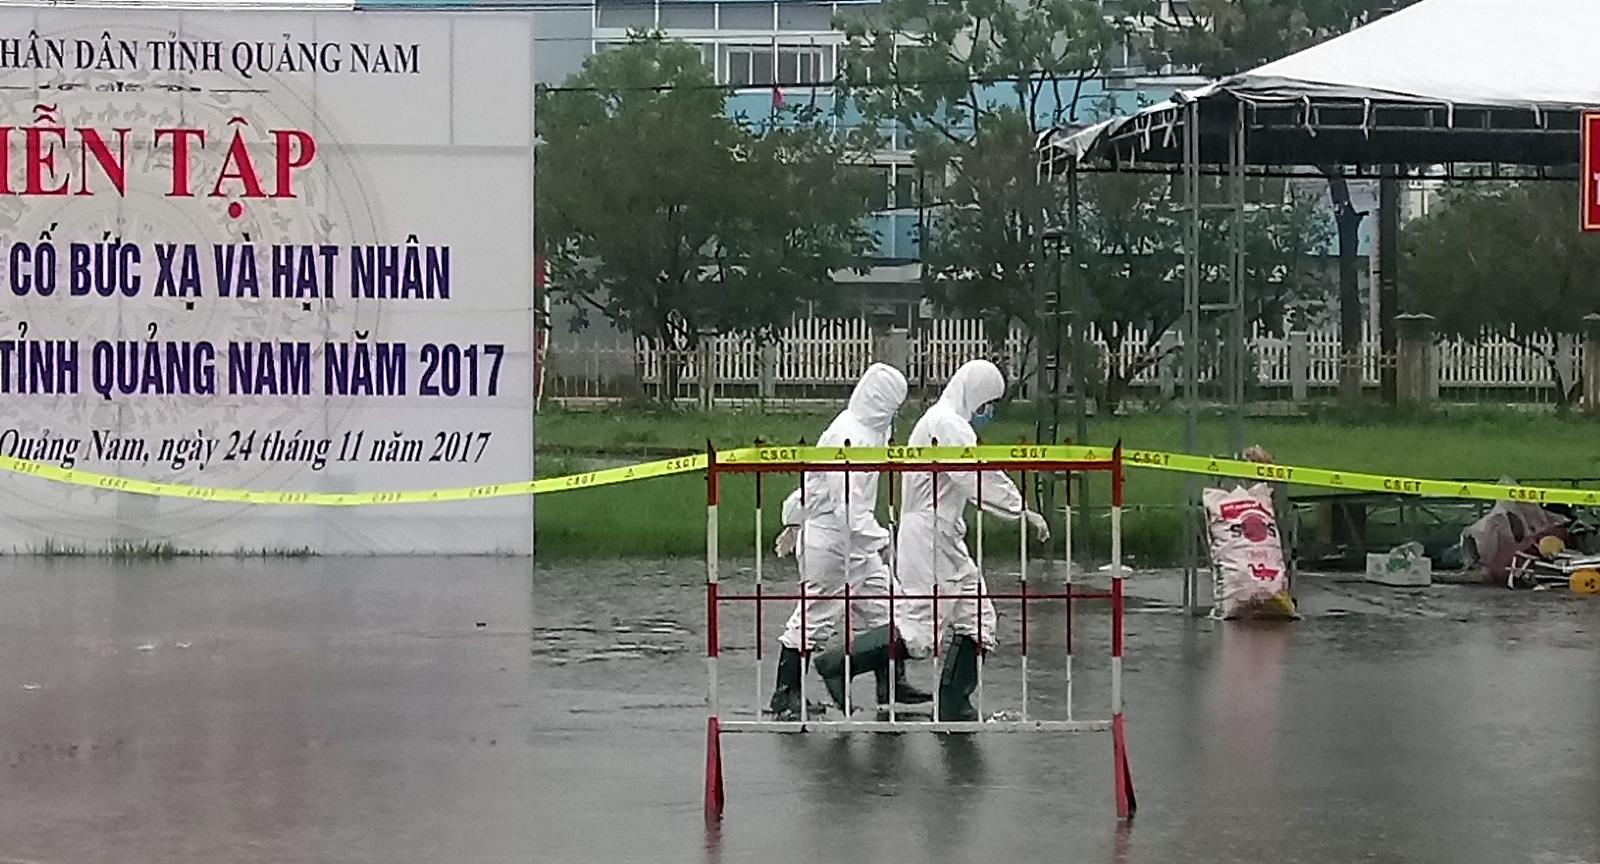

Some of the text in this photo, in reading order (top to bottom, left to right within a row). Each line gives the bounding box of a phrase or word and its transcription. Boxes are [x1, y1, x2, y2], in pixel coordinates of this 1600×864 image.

[74, 31, 138, 70] DÂN
[147, 30, 222, 72] TỈNH
[231, 33, 342, 78] QUẢNG
[350, 43, 420, 73] NAM
[153, 117, 316, 218] TẬP
[10, 223, 450, 311] CỐ BỨC XẠ VÀ HẠT NHÂN
[0, 322, 505, 400] TỈNH QUẢNG NAM NĂM 2017
[0, 429, 492, 471] Quảng Nam, ngày 24 tháng 11 năm 2017
